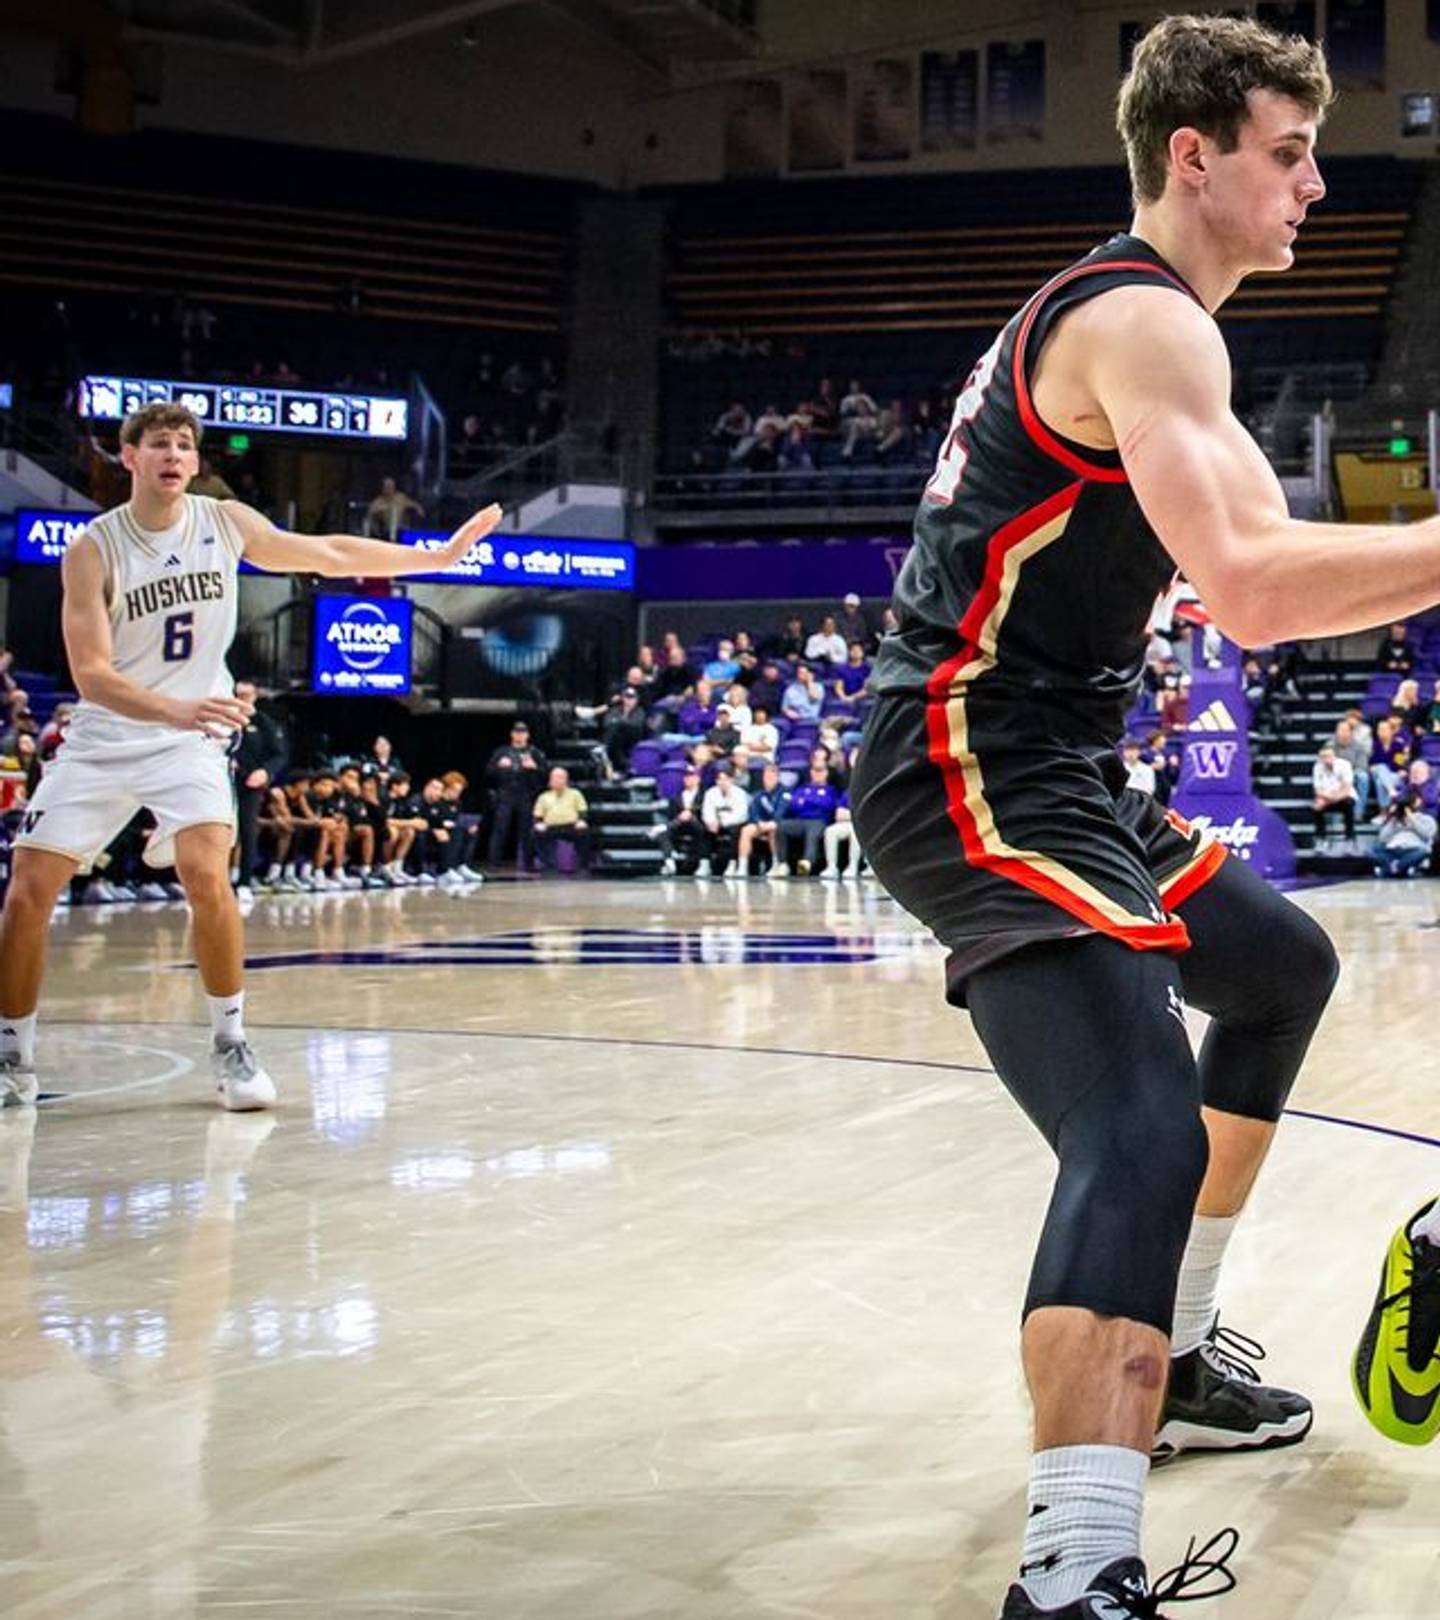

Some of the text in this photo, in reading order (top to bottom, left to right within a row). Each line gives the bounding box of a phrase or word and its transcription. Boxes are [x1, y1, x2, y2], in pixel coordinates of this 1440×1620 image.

[125, 571, 224, 621] HUSKIES
[162, 611, 194, 662] 6
[1188, 742, 1237, 778] W
